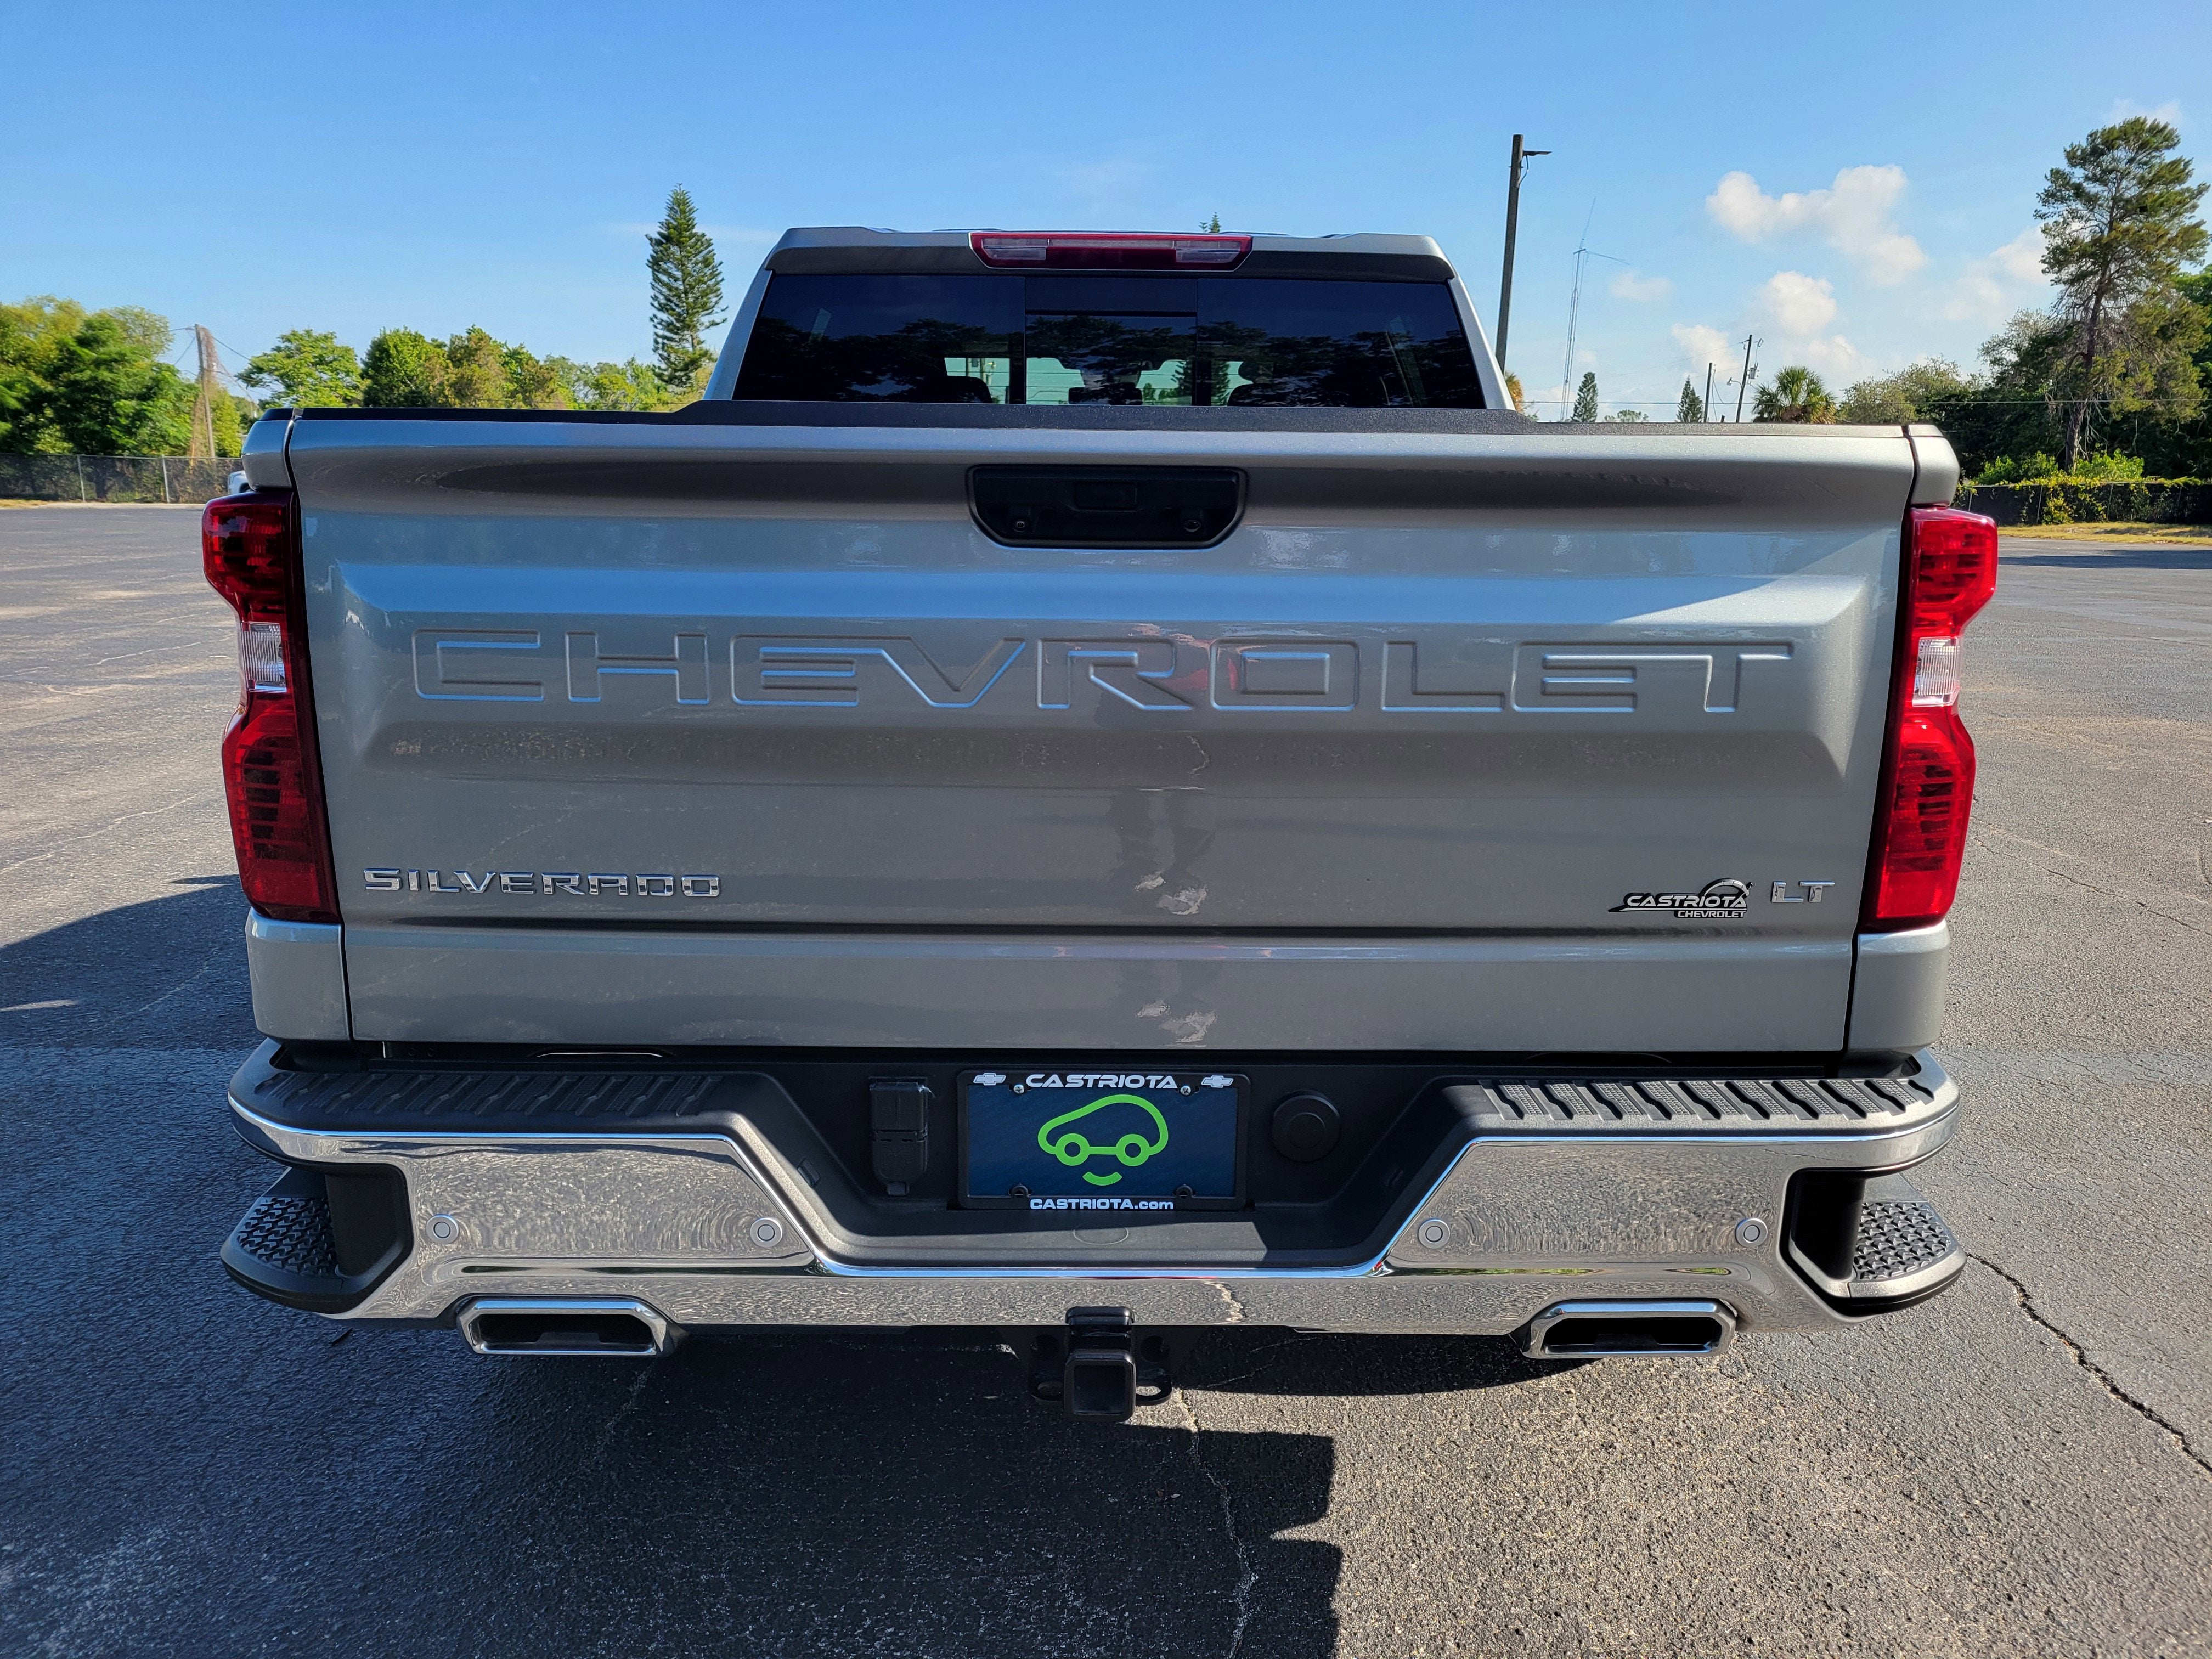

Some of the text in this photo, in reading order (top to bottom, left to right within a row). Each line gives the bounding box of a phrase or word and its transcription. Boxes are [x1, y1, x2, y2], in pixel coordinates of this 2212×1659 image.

[411, 629, 1795, 713] CHEVROLET
[363, 868, 720, 898] SILVERADO
[1771, 881, 1836, 903] LT
[1627, 895, 1747, 907] CASTRIOTA
[1026, 1074, 1178, 1088] CASTRIOTA
[1030, 1198, 1174, 1210] CASTRIOTA.com
